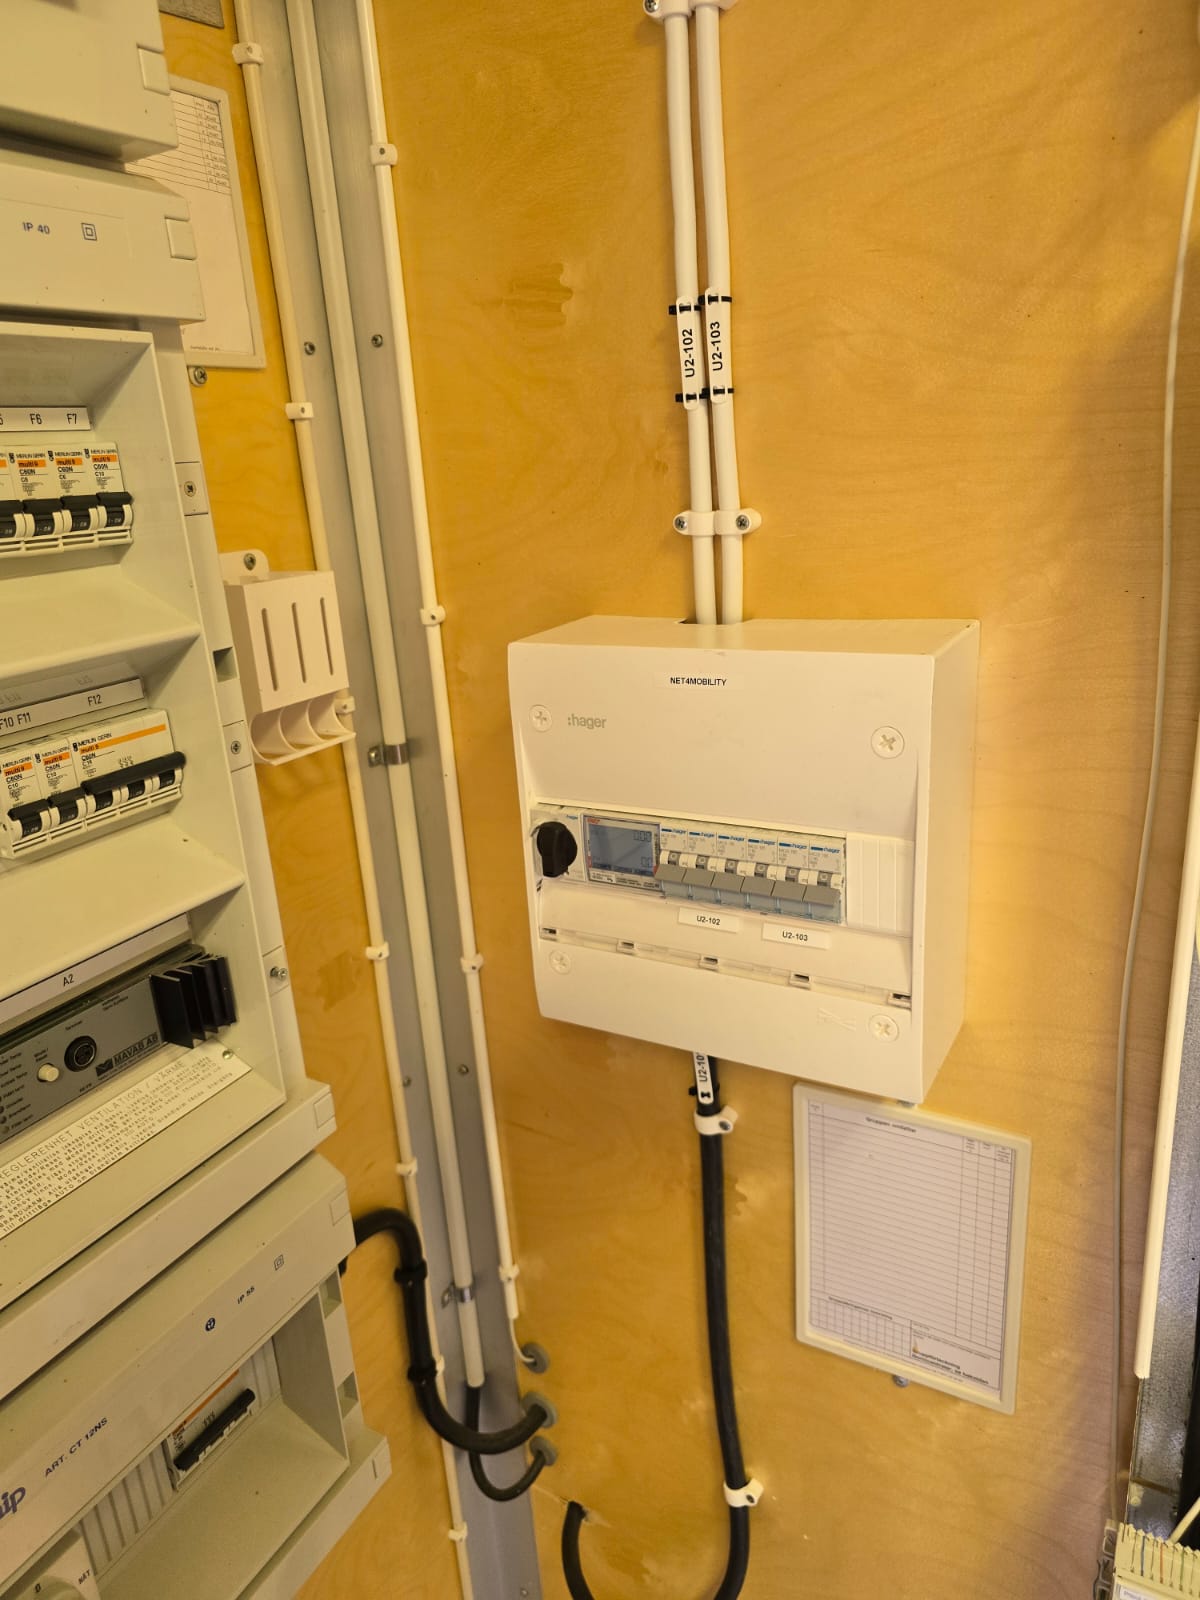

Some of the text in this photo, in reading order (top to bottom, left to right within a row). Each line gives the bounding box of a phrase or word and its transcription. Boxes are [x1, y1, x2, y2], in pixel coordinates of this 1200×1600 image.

[22, 221, 50, 235] IP 40
[682, 328, 695, 378] U2-102
[710, 321, 723, 372] U2-103
[29, 413, 43, 425] F6
[66, 413, 77, 425] F7
[669, 676, 727, 687] NET4MOBILITY
[0, 694, 103, 730] F10 F11 F12
[696, 915, 721, 926] U2-102
[782, 930, 808, 942] U2-103
[63, 974, 74, 986] A2
[695, 1052, 708, 1082] U2-10
[75, 1086, 143, 1131] VENTILATION
[151, 1059, 185, 1083] VÄRME
[237, 1294, 245, 1304] IP
[45, 1417, 108, 1478] ART. CT 12NS
